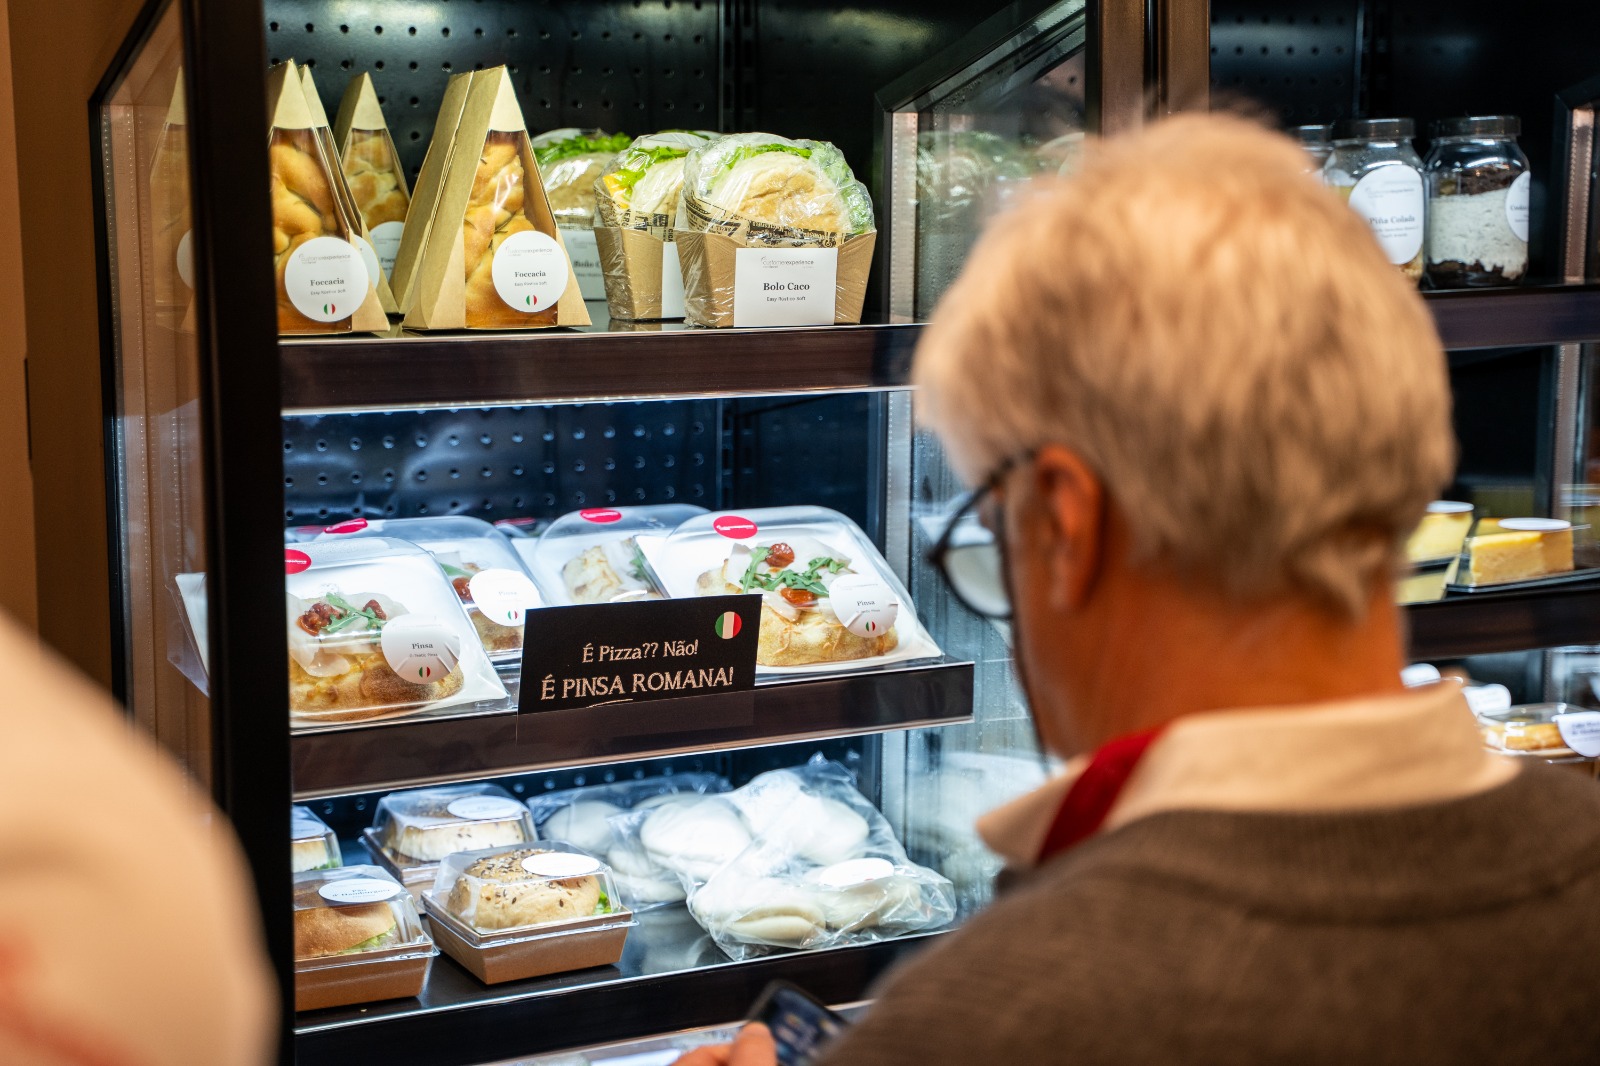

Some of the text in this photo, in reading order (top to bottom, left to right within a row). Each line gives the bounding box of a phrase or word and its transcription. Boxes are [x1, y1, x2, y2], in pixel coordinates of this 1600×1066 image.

[1390, 214, 1416, 223] Colada
[514, 270, 547, 278] Foccacia
[309, 277, 345, 287] Foccacia
[763, 281, 811, 291] Bolo Caco
[411, 642, 434, 650] Pinsa
[582, 639, 699, 663] É Pizza?? Não!
[540, 666, 734, 700] É PINSA ROMANA!
